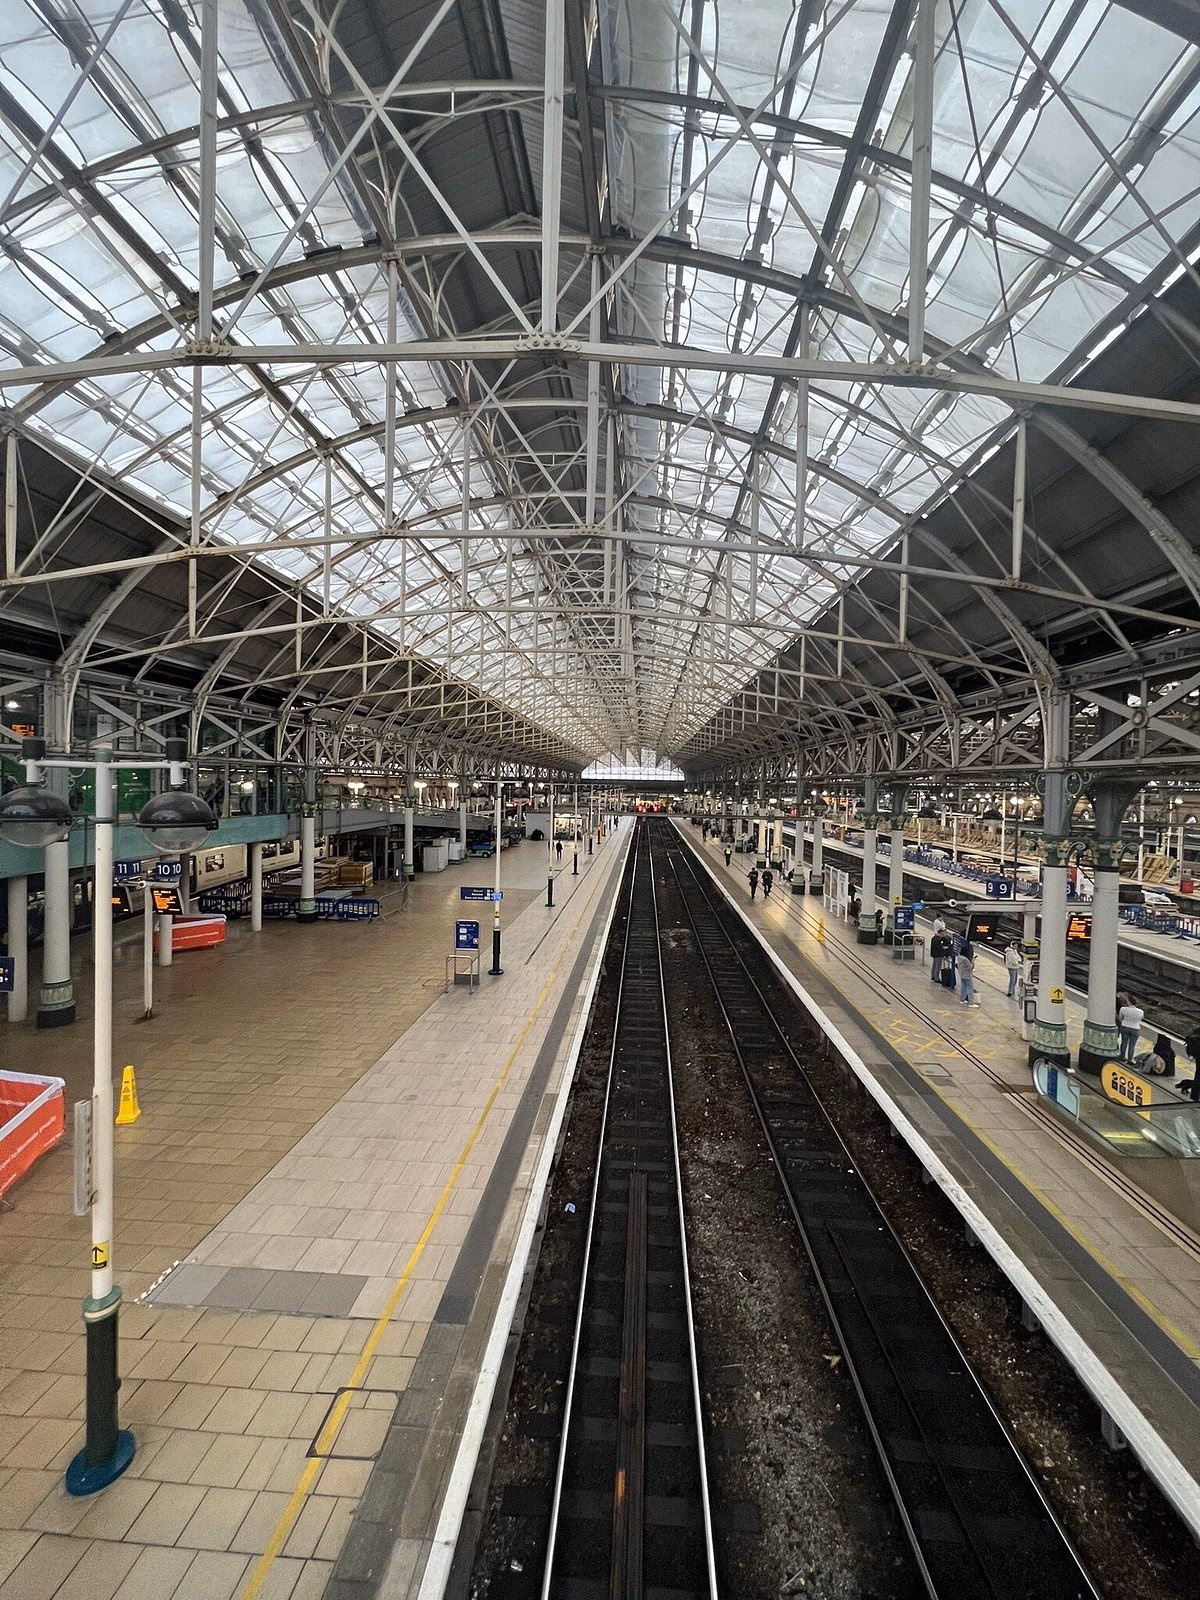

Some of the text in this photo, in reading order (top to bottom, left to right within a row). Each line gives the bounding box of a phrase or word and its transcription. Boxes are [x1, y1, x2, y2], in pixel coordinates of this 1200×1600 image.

[118, 864, 127, 874] 11
[133, 863, 140, 873] 11
[157, 864, 170, 875] 10
[172, 863, 181, 874] 10
[987, 882, 993, 892] 9
[999, 883, 1007, 894] 9
